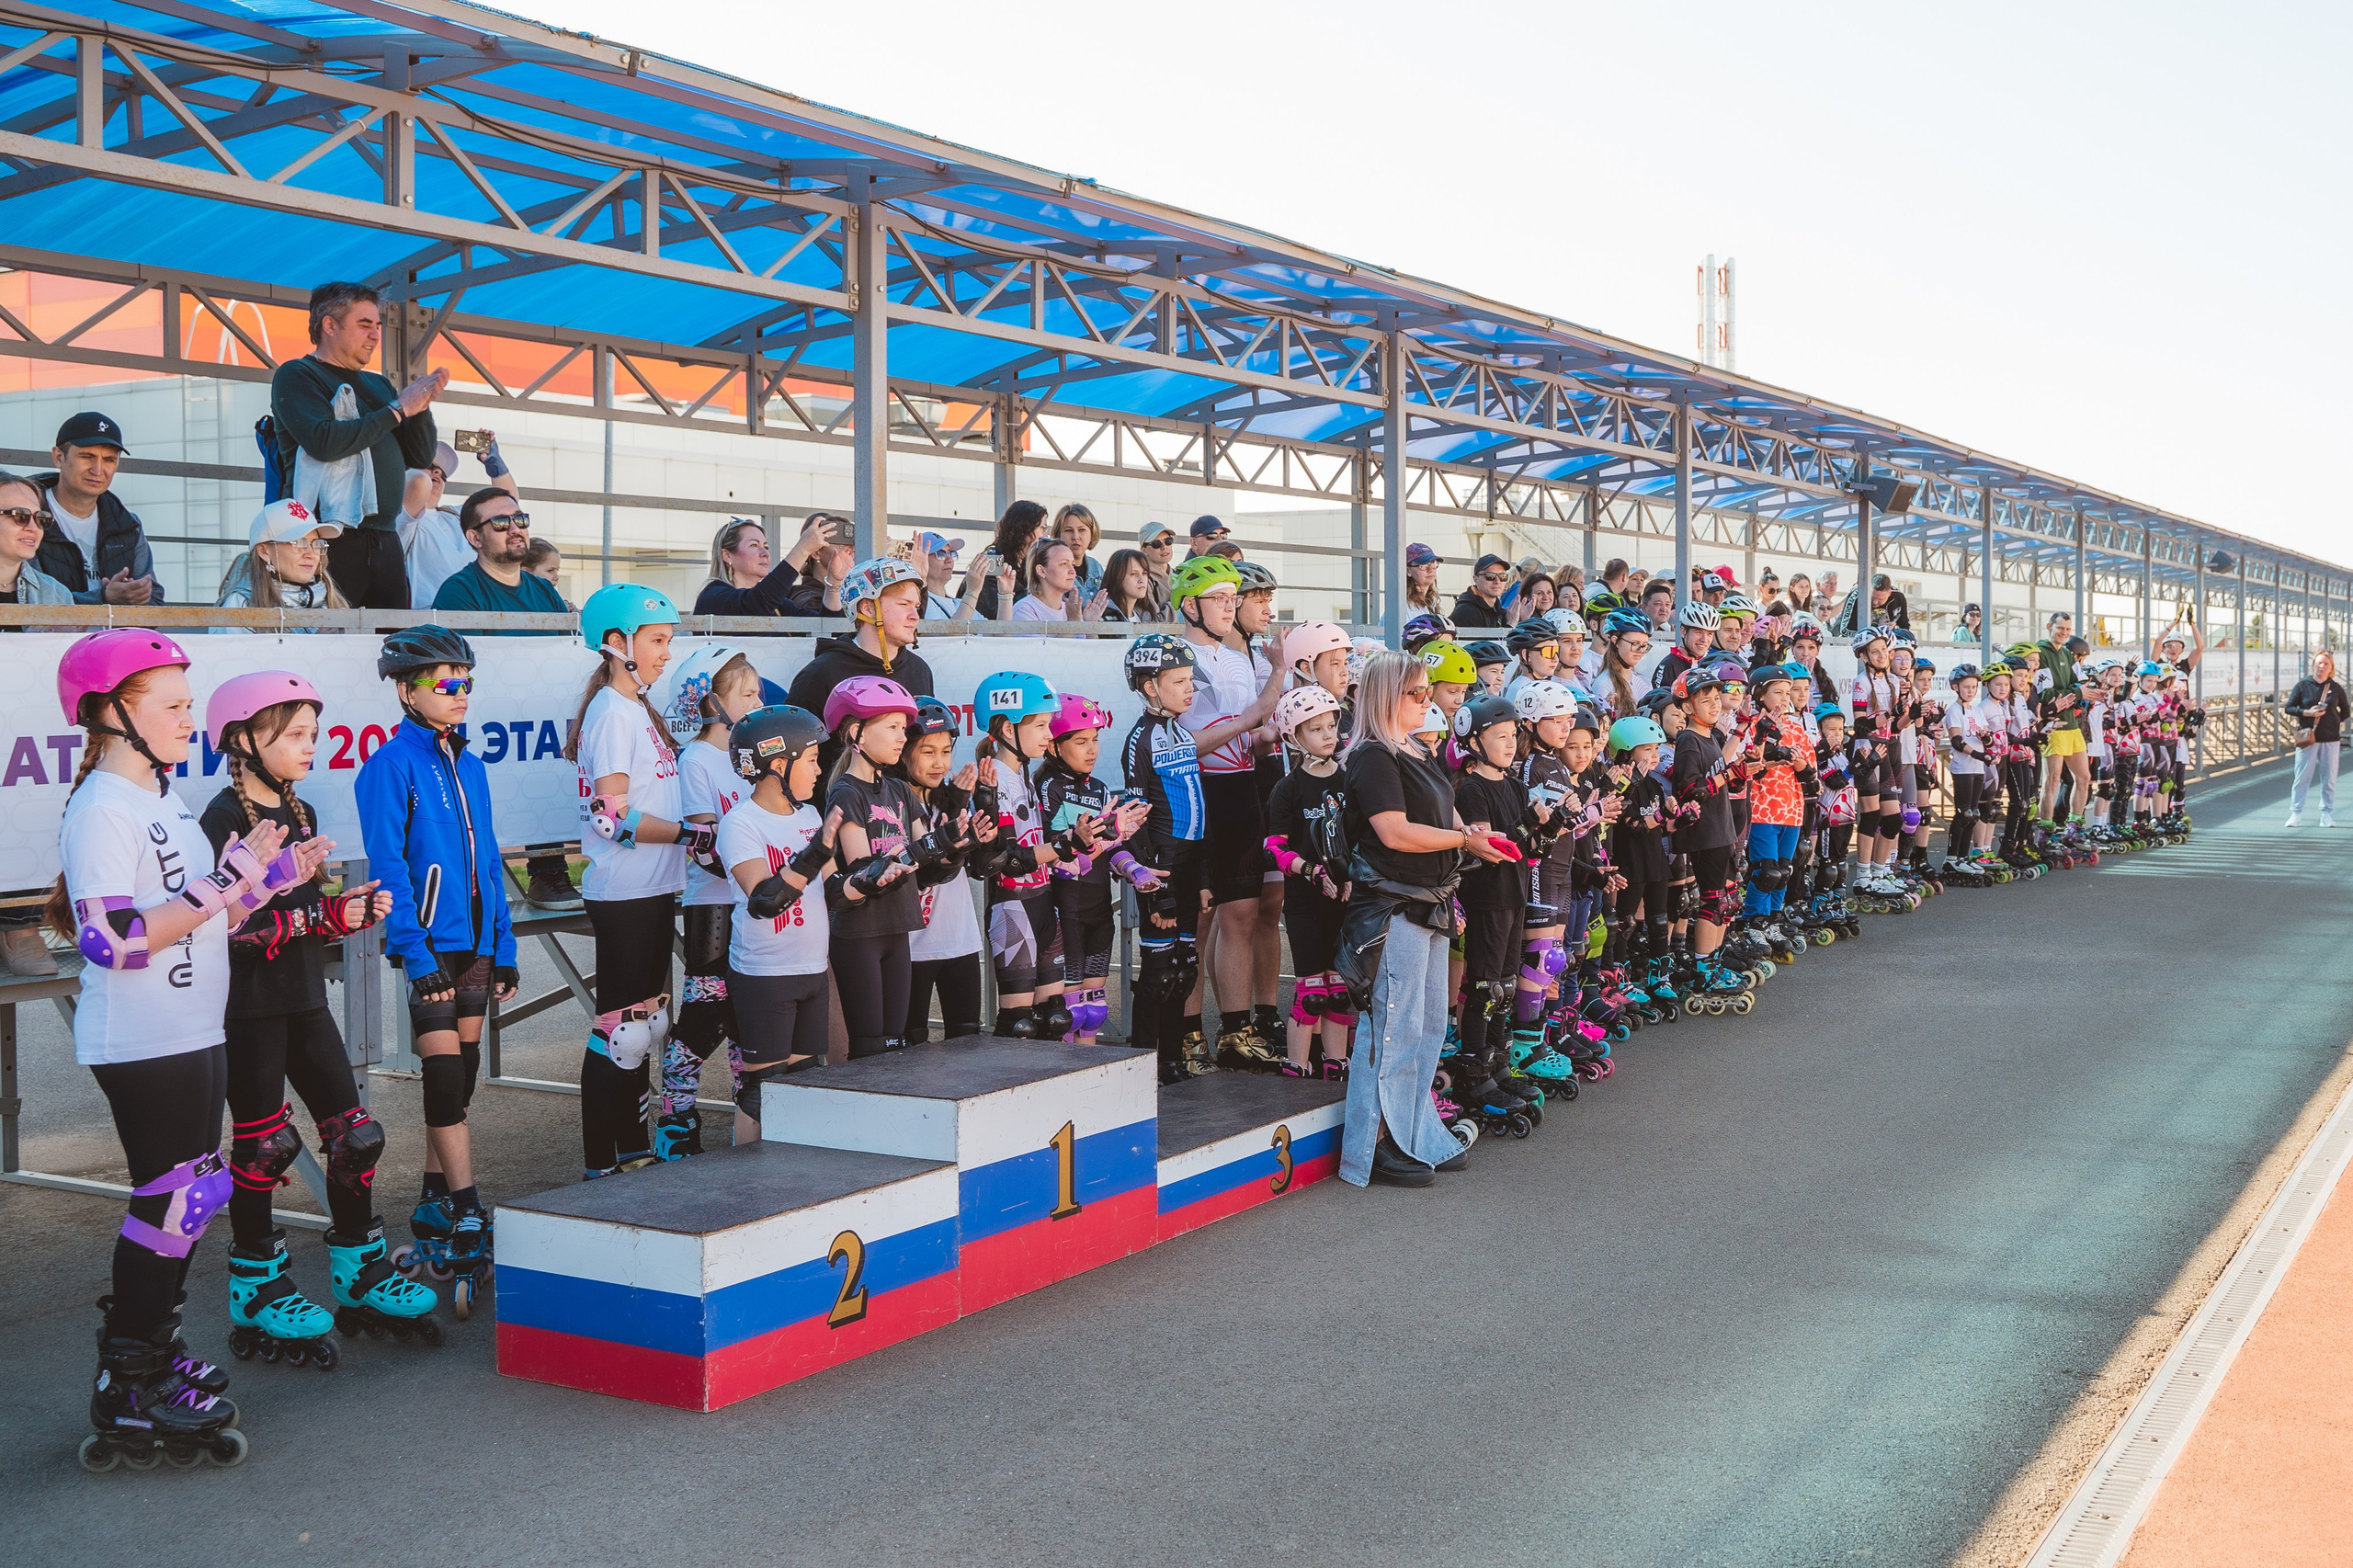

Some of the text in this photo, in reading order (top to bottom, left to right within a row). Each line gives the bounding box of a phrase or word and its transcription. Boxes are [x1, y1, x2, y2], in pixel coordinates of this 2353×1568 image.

[1134, 650, 1159, 663] 394
[1427, 654, 1439, 665] 57
[991, 690, 1018, 706] 141
[1523, 697, 1533, 709] 12
[1268, 1124, 1294, 1196] 3
[1049, 1119, 1083, 1221] 1
[825, 1229, 869, 1331] 2
